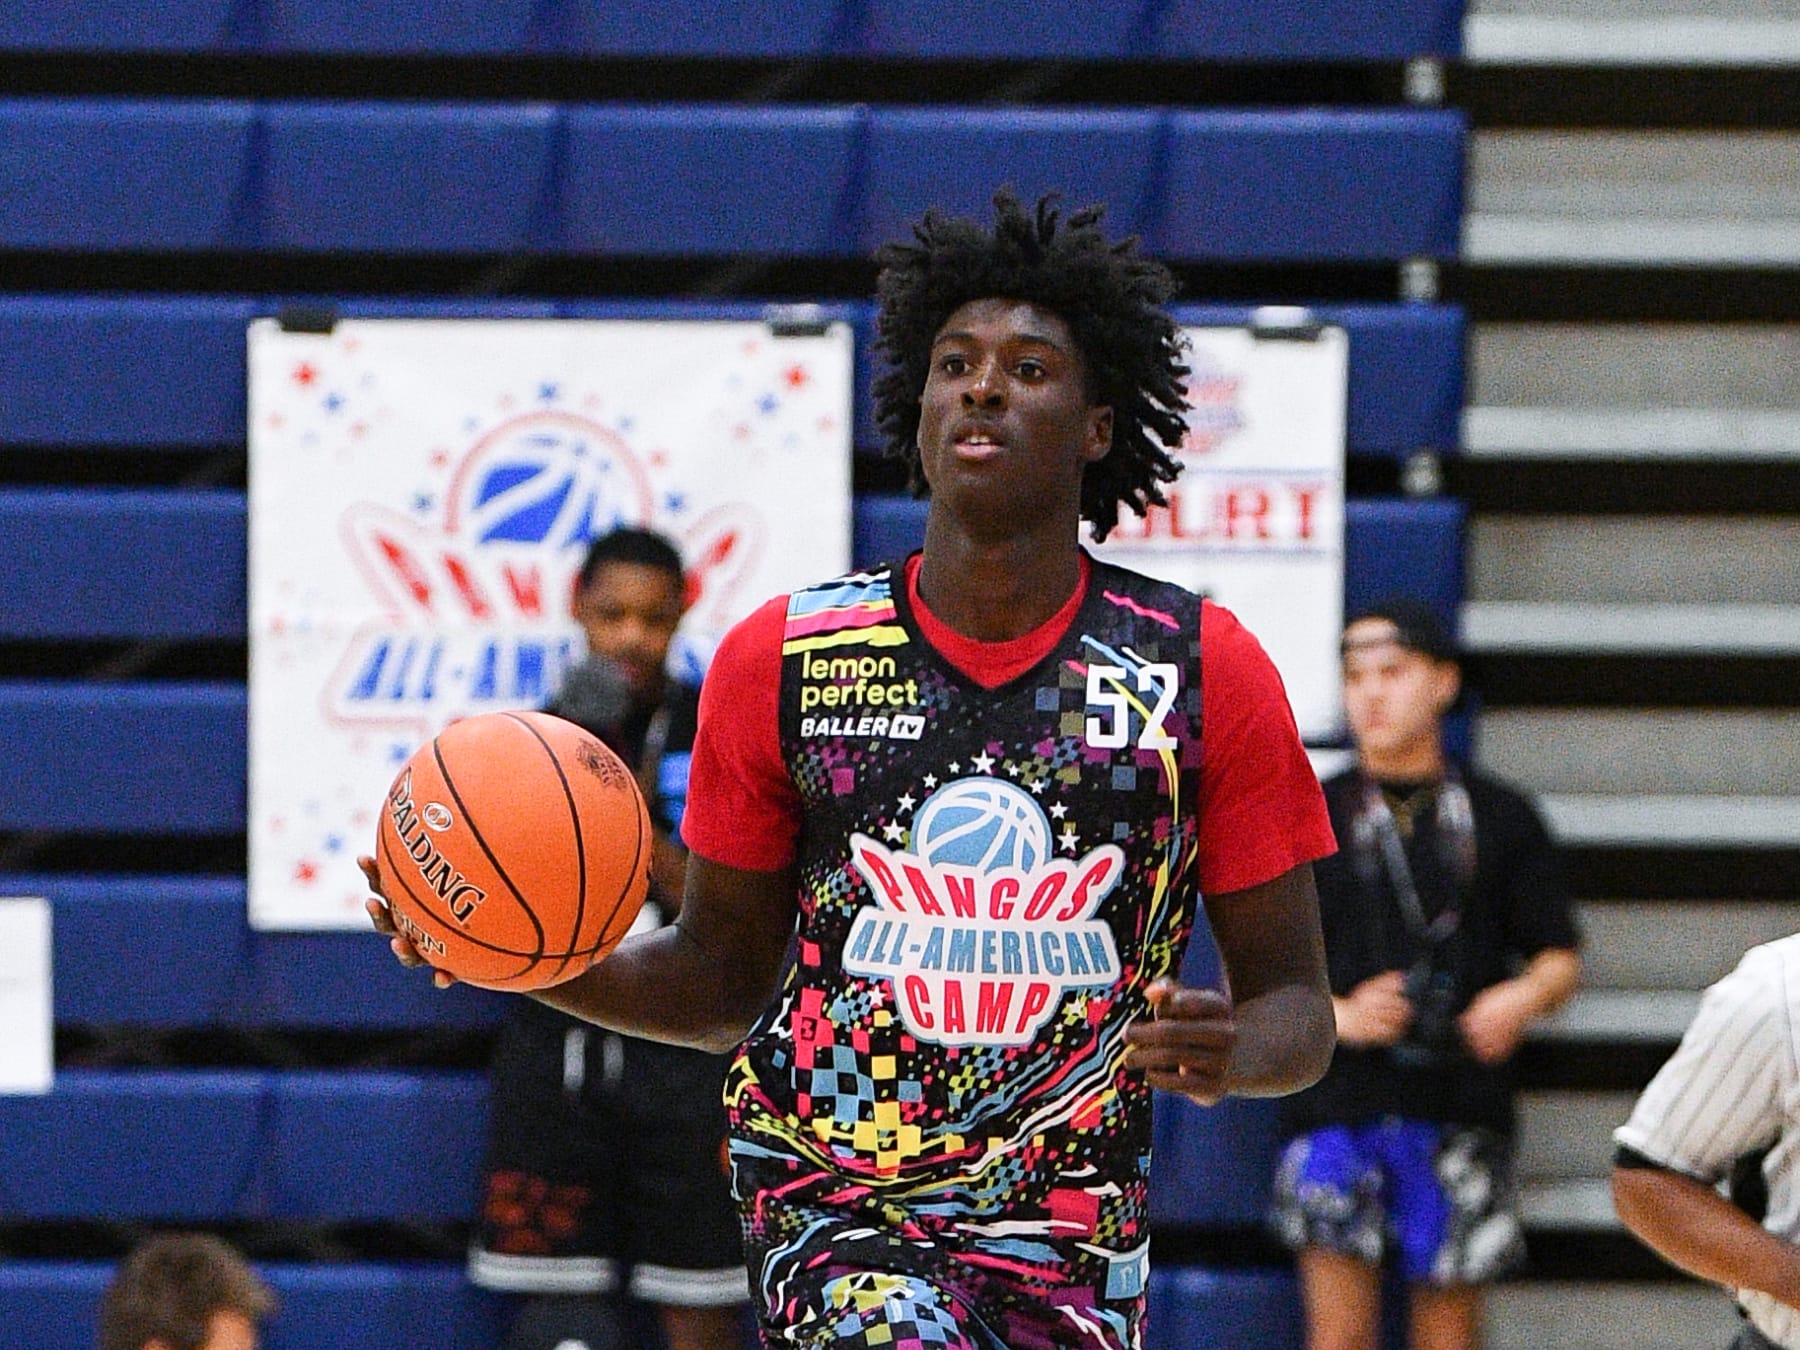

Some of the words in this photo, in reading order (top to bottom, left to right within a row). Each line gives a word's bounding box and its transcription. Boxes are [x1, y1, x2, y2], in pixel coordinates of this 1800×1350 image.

[801, 678, 918, 713] perfect
[802, 651, 896, 680] lemon
[1086, 663, 1179, 750] 52
[859, 846, 1113, 921] PANGOS
[849, 918, 1110, 977] ALL-AMERICAN
[903, 974, 1051, 1035] CAMP
